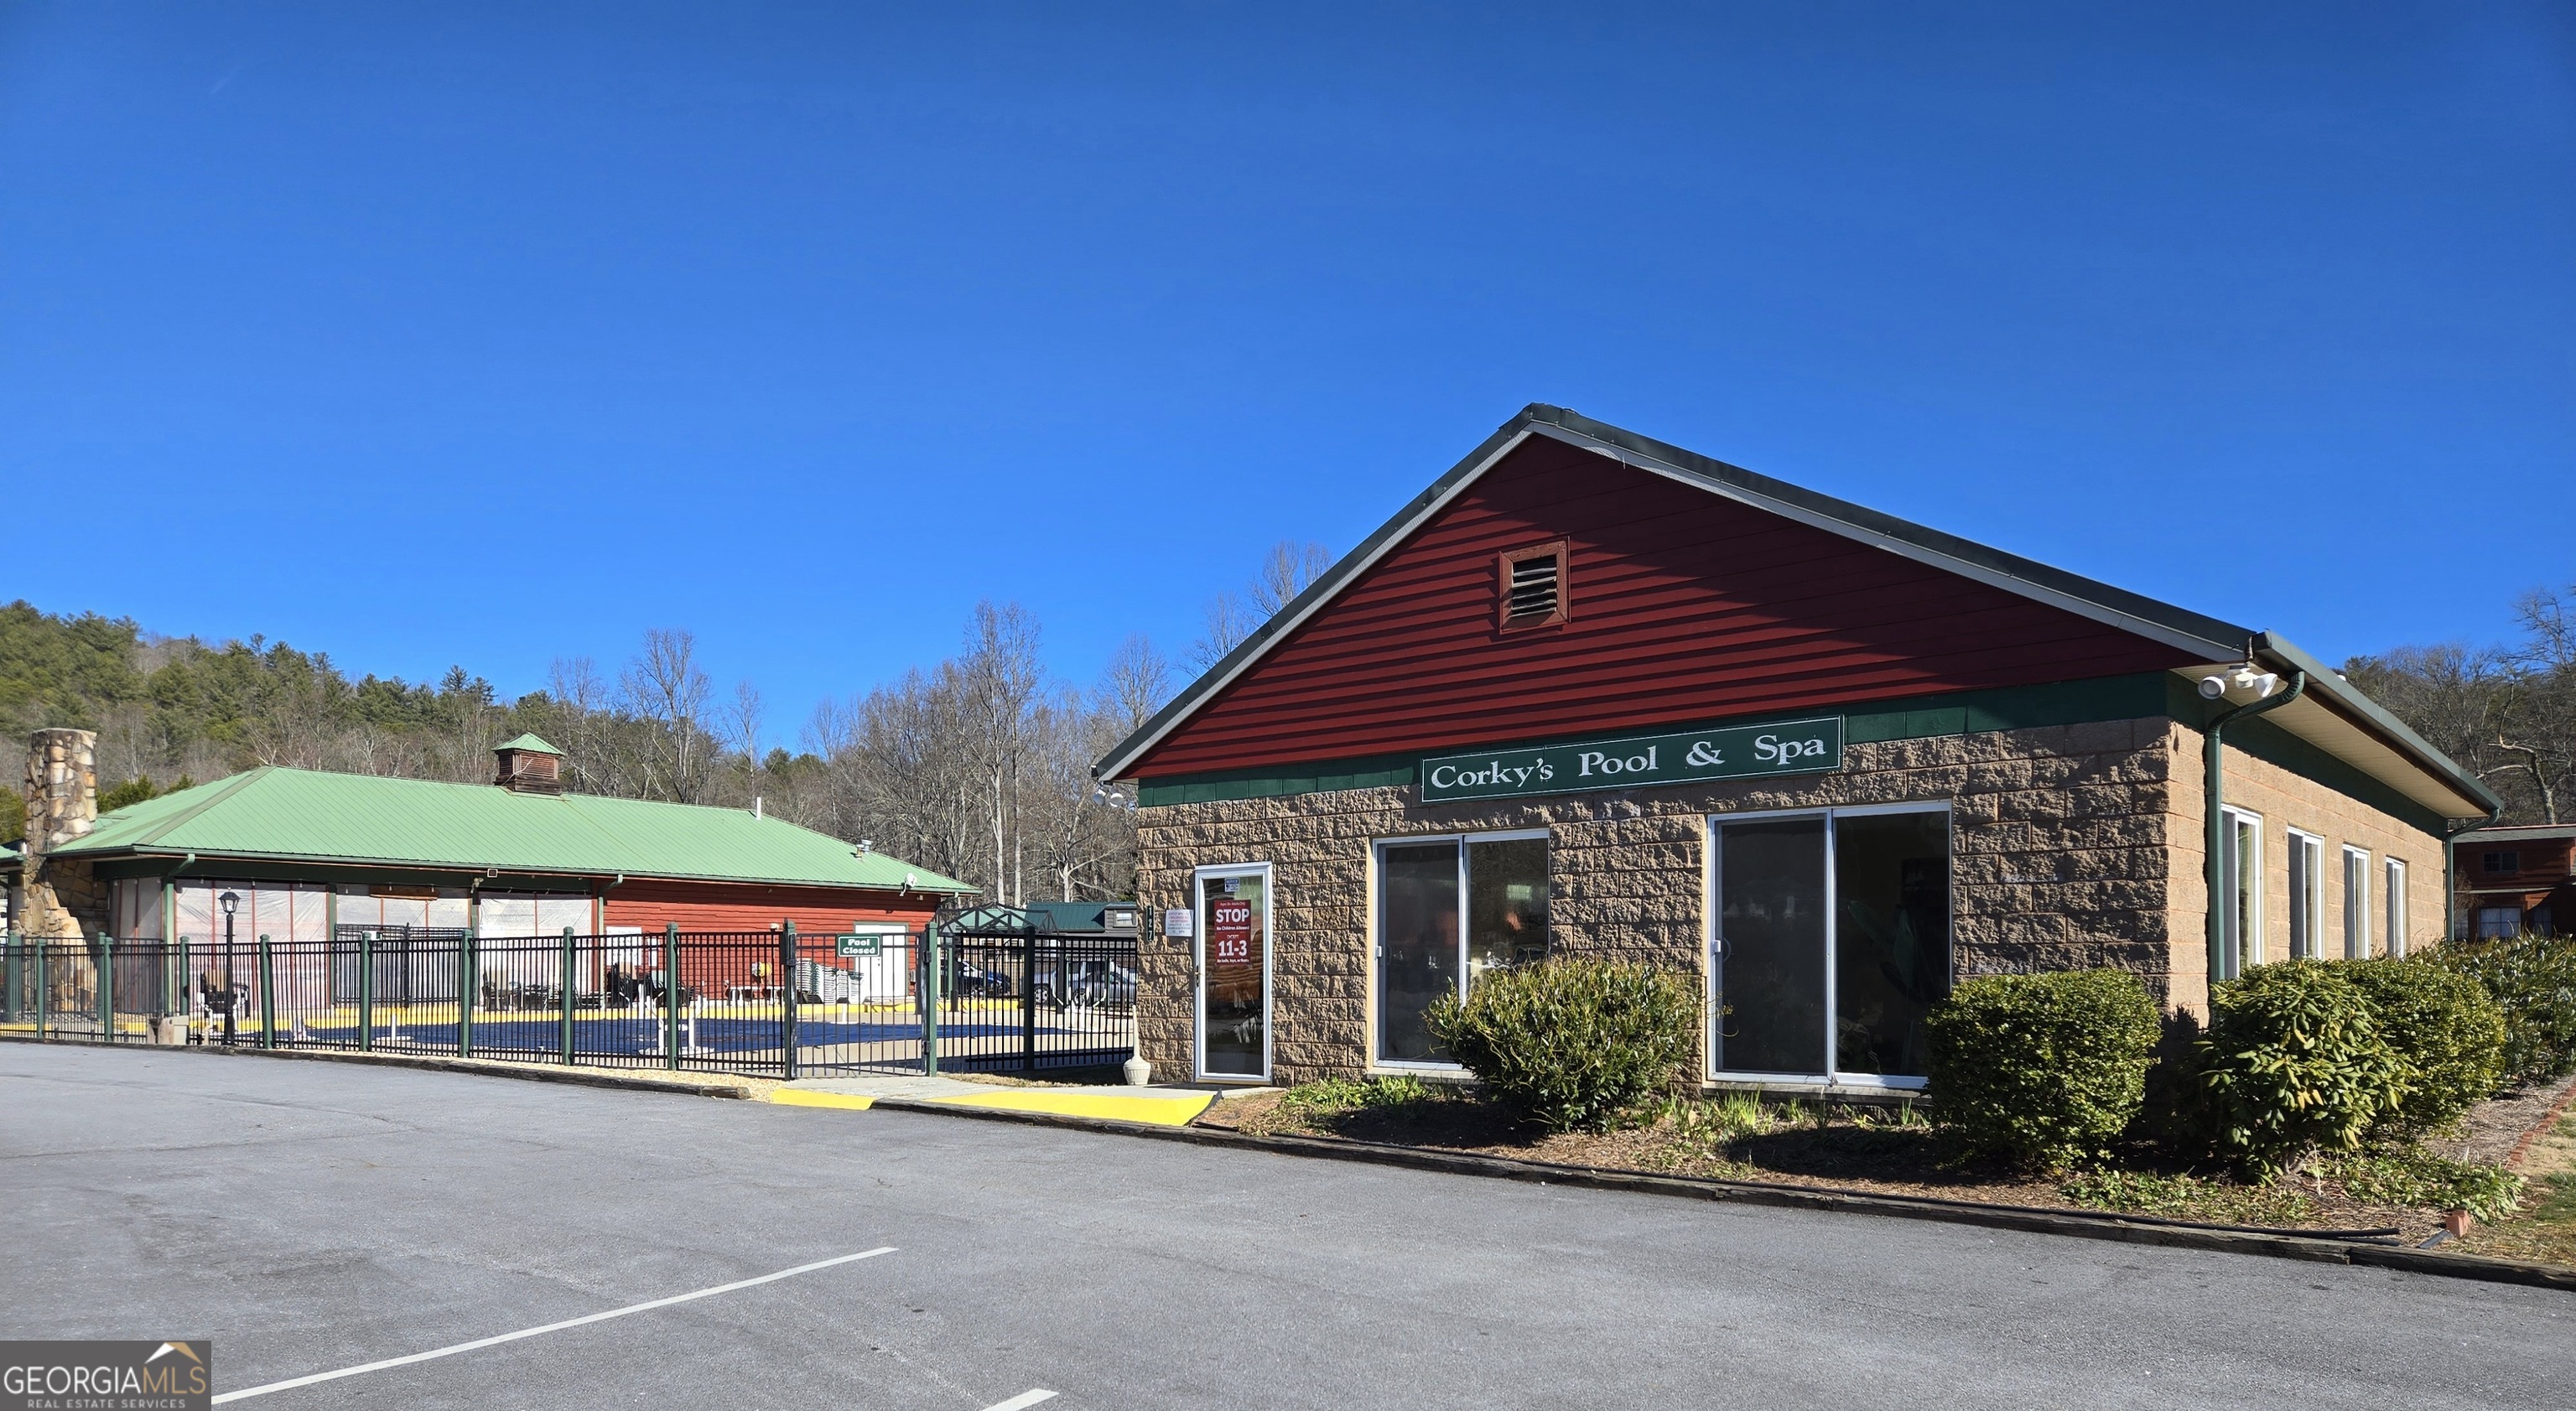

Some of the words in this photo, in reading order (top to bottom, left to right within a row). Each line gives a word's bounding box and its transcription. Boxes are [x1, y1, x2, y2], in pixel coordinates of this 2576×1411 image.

[1431, 757, 1554, 789] Corky's
[1578, 744, 1659, 776] Pool
[1685, 741, 1726, 766] &
[1754, 734, 1827, 766] Spa
[1216, 908, 1249, 923] STOP
[1218, 940, 1247, 957] 11-3
